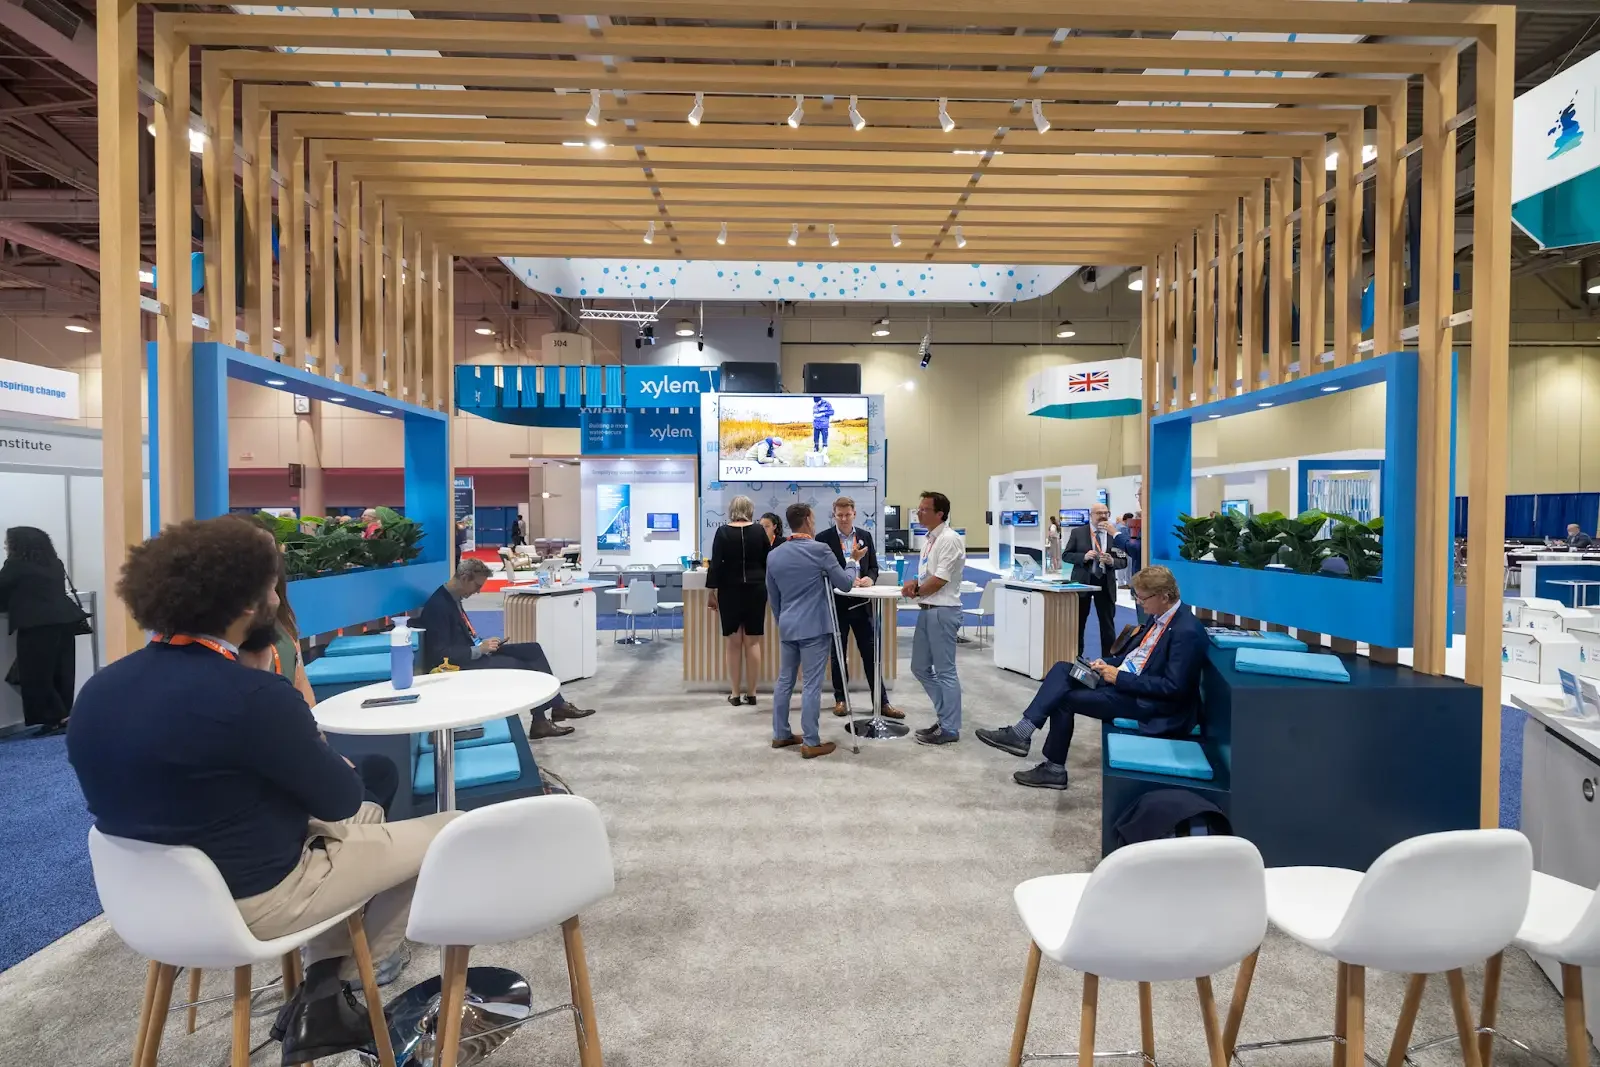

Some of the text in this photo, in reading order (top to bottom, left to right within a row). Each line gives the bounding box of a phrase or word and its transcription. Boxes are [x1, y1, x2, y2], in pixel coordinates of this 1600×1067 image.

[0, 380, 66, 398] nspiring change
[640, 374, 700, 399] xylem
[649, 424, 693, 441] xylem
[0, 438, 52, 451] nstitute
